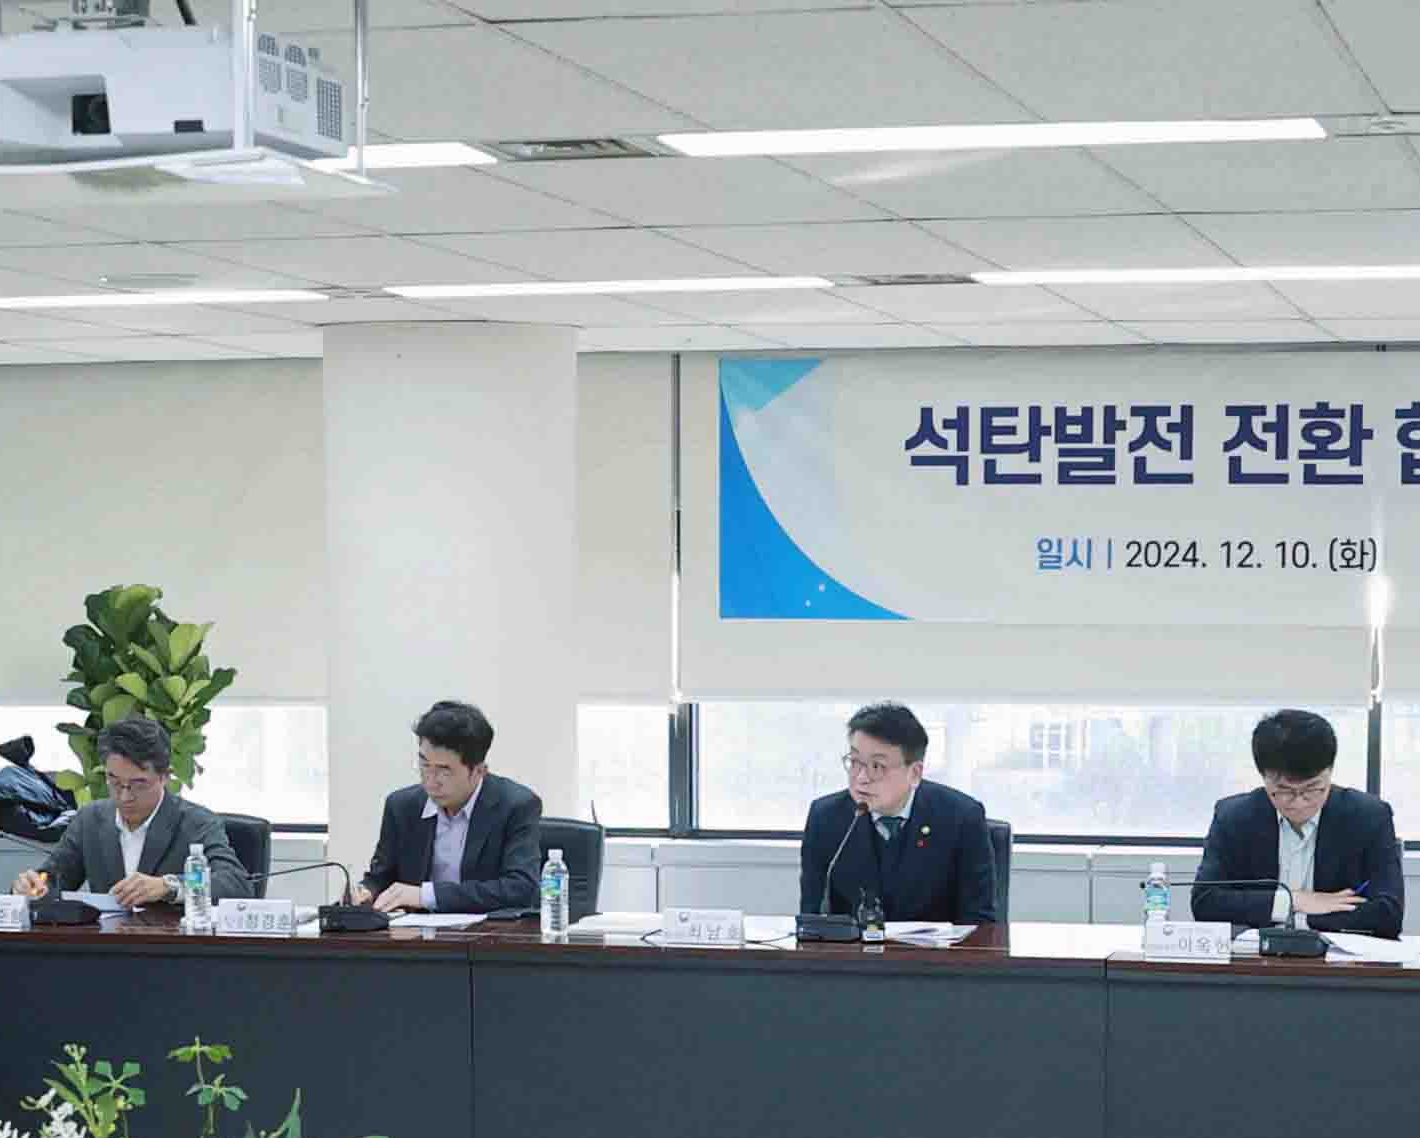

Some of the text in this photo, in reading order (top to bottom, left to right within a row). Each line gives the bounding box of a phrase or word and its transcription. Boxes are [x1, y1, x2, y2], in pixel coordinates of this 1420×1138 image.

[903, 403, 1195, 487] 석탄발전
[1221, 400, 1375, 486] 전환
[1036, 536, 1378, 573] 일시 2024. 12. 10. (화)
